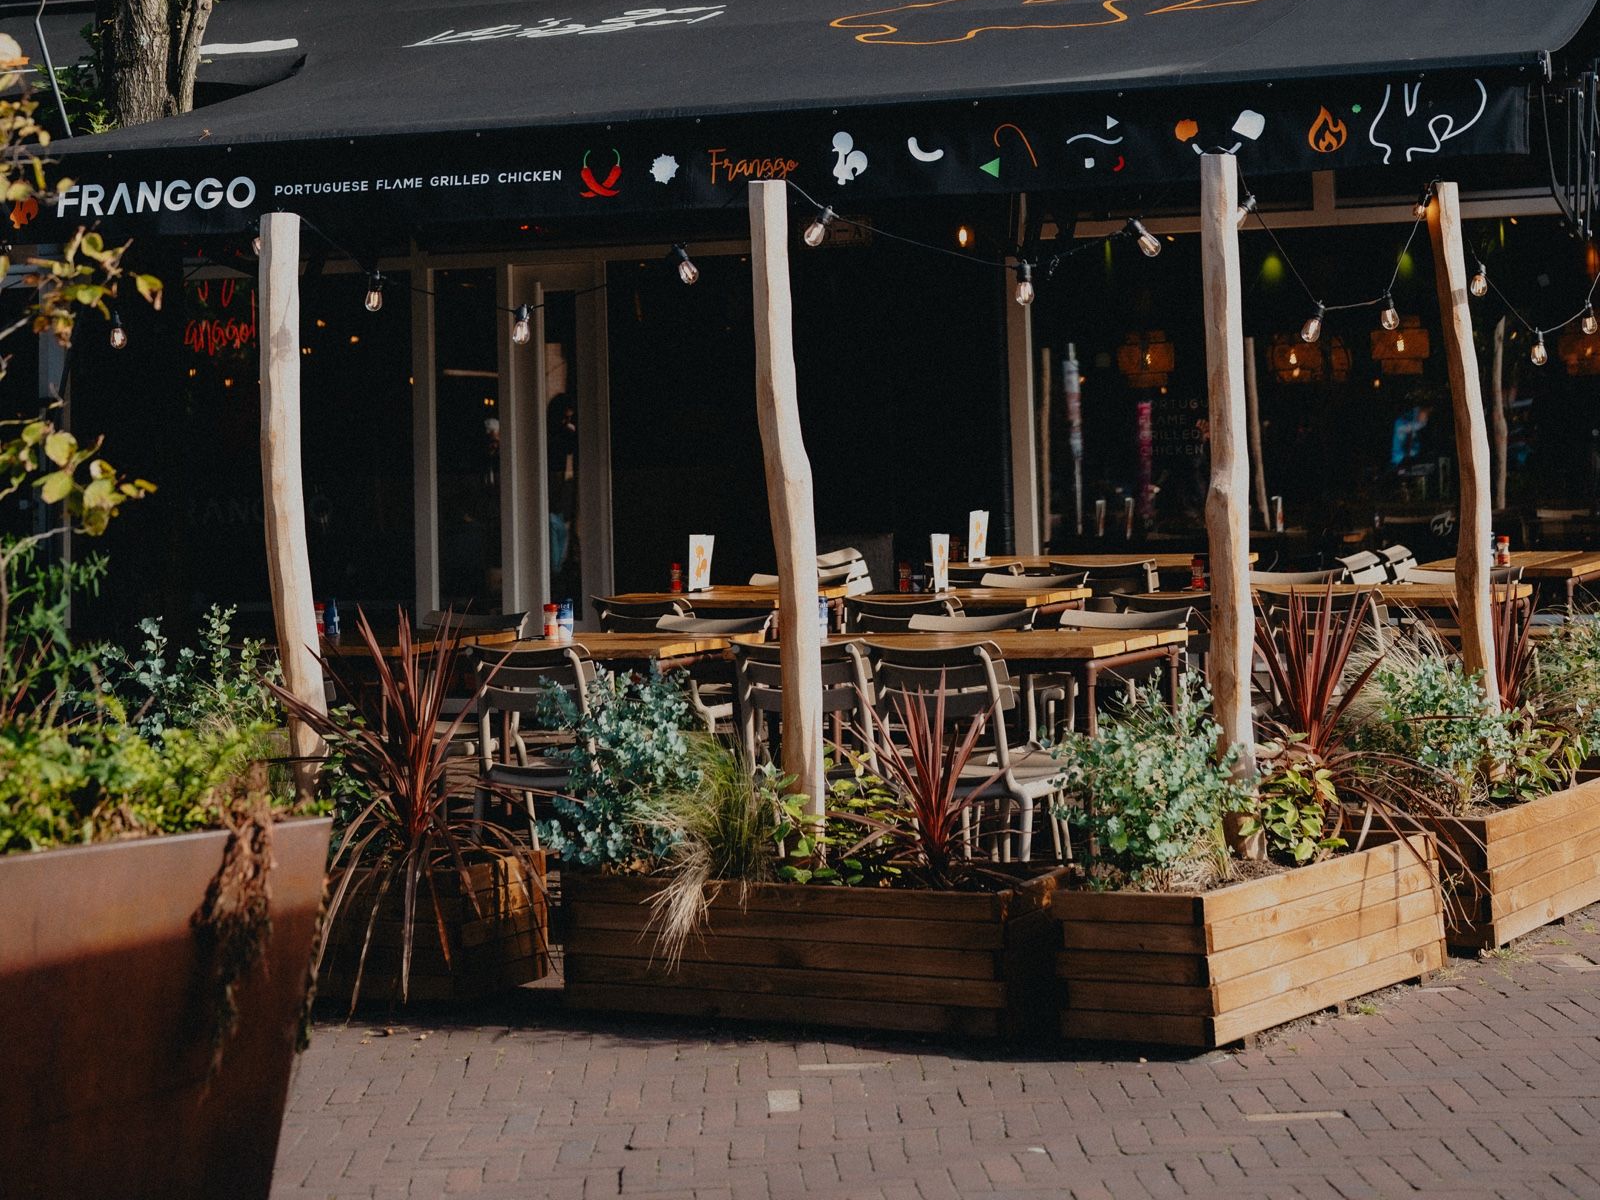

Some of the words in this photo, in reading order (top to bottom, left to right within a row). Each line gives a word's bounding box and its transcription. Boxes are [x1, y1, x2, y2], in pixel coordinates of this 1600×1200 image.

[274, 181, 369, 196] PORTUGUESE
[375, 177, 423, 191] FLAME
[430, 173, 490, 187] GRILLED
[497, 169, 562, 184] CHICKEN
[708, 148, 799, 185] Franggo
[57, 176, 256, 218] FRANGGO
